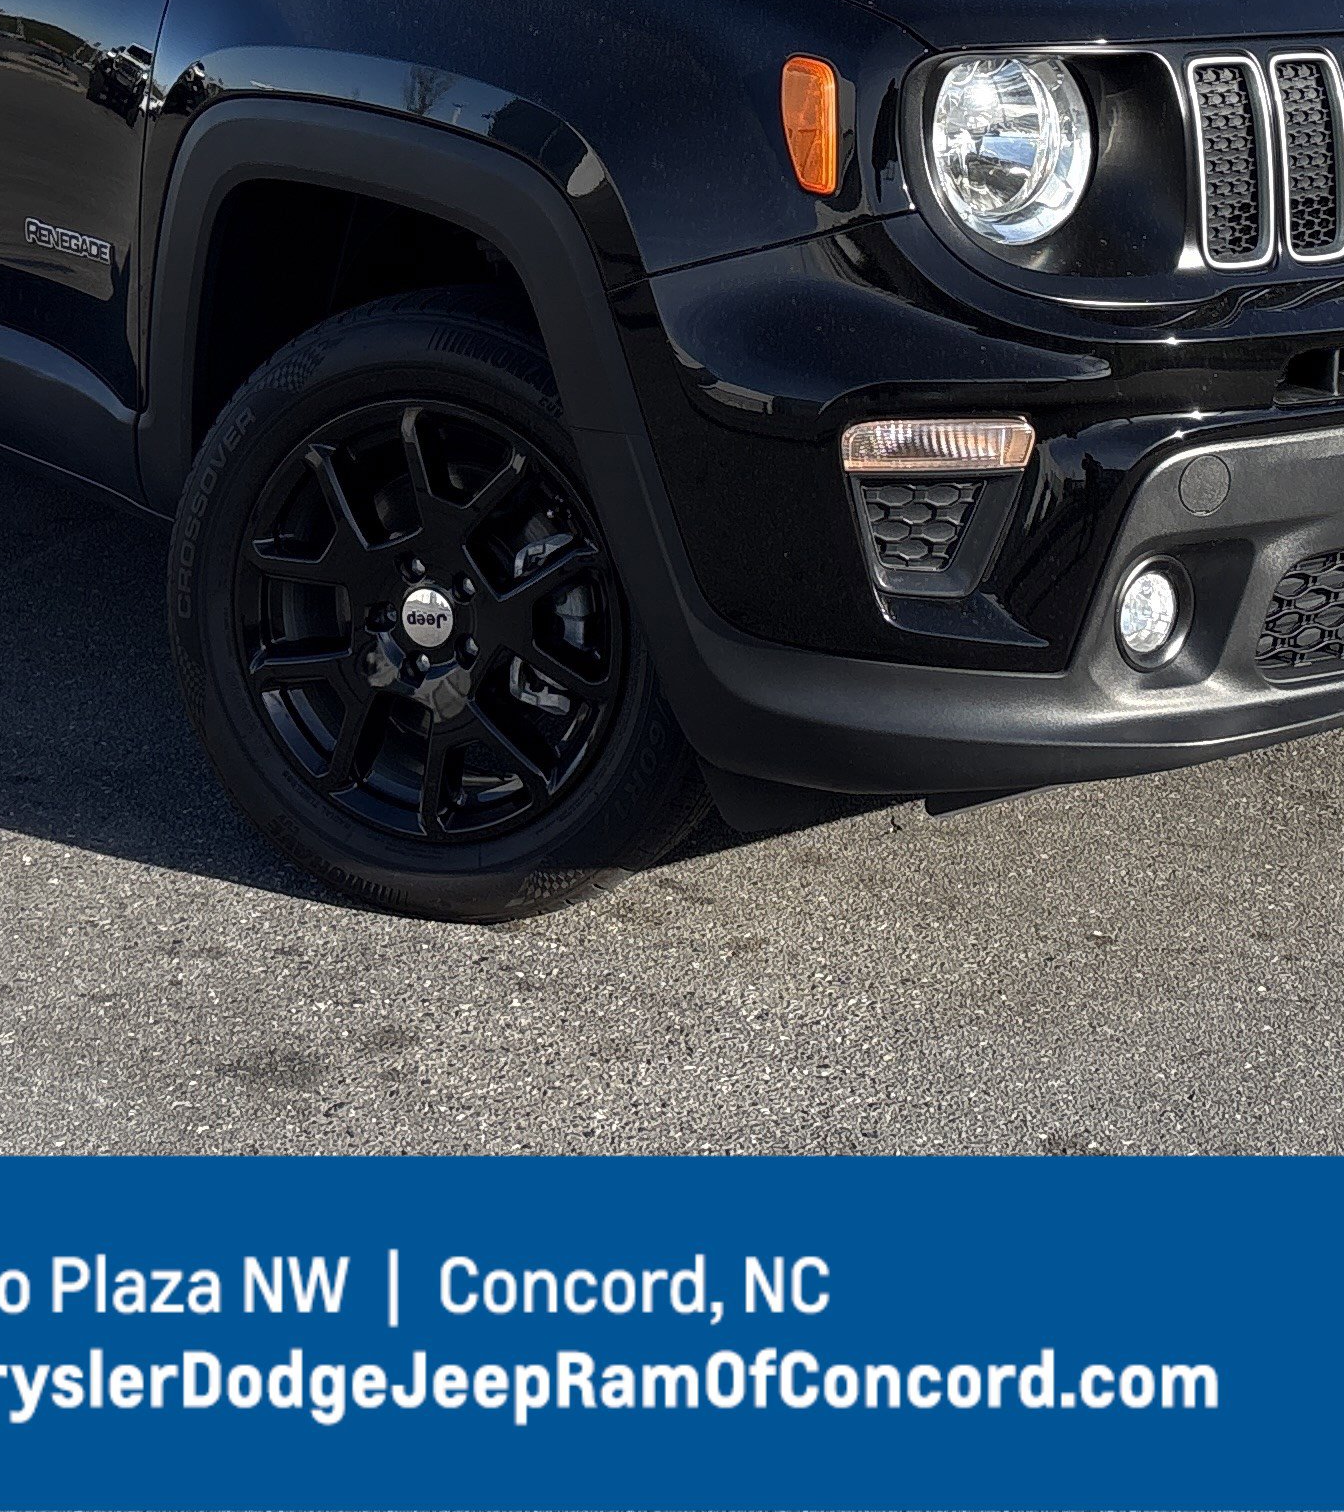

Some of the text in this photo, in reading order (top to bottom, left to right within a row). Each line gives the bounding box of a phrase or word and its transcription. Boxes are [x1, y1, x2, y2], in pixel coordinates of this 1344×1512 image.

[25, 217, 111, 264] RENEGADE
[175, 405, 258, 618] CROSSOVER
[405, 609, 448, 632] Jeep
